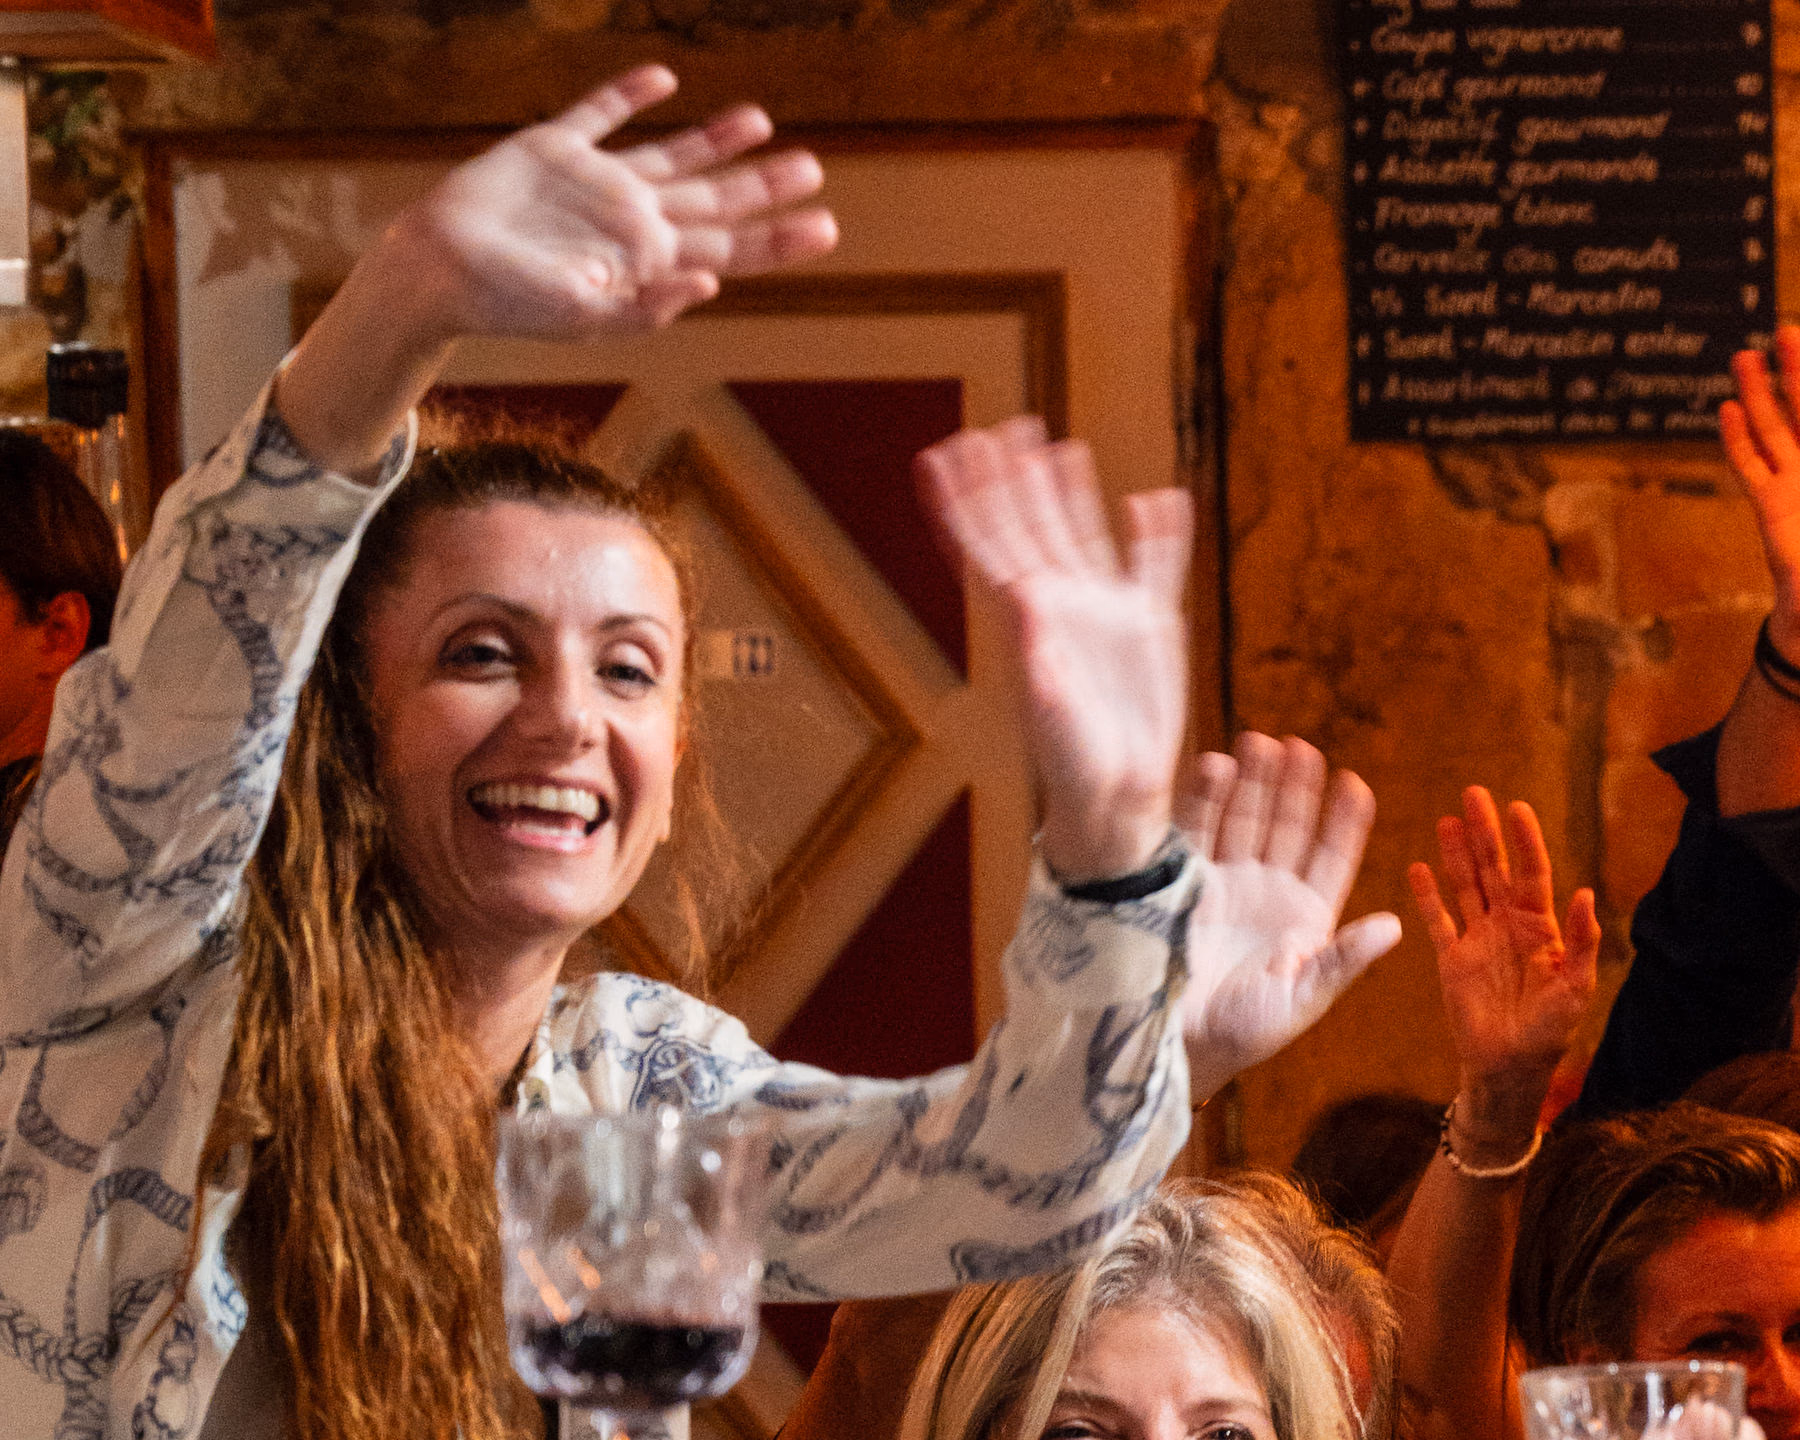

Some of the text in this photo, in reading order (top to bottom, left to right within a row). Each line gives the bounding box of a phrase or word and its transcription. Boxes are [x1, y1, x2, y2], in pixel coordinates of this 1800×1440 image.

[1450, 70, 1607, 114] gourmand
[1511, 110, 1671, 156] gourmand
[1499, 151, 1658, 200] gourmande
[1375, 193, 1596, 246] Fromage blanc
